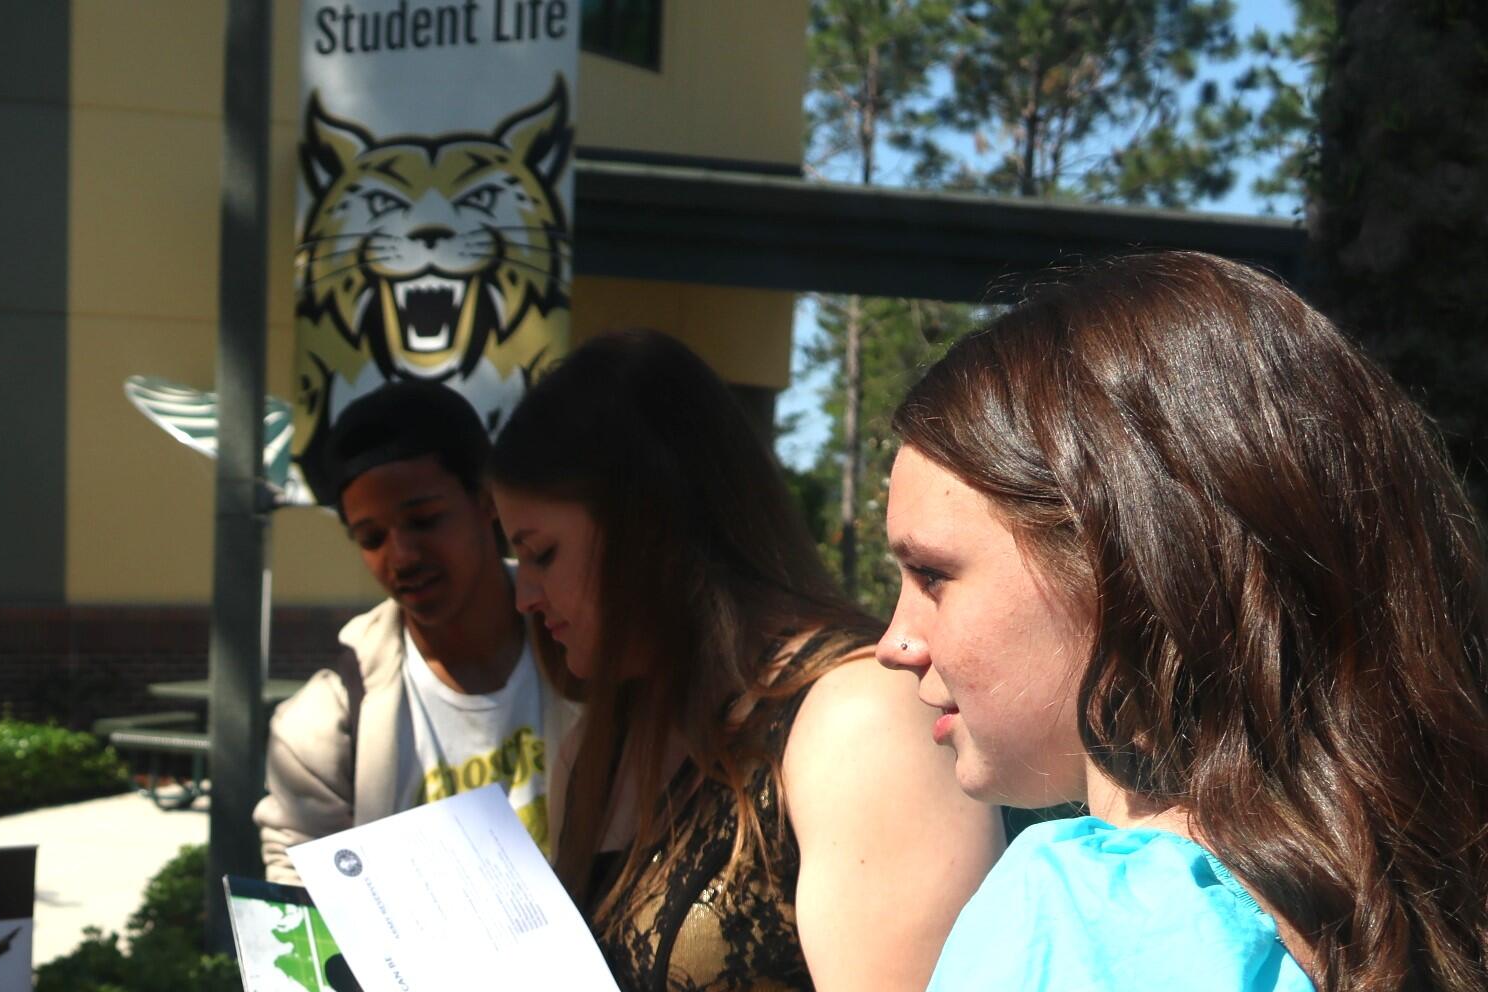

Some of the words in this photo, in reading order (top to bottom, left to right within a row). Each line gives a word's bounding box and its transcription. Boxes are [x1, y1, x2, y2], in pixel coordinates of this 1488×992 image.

[315, 0, 478, 55] Student
[492, 0, 568, 42] Life
[384, 956, 397, 970] BE
[392, 970, 410, 992] CAN
